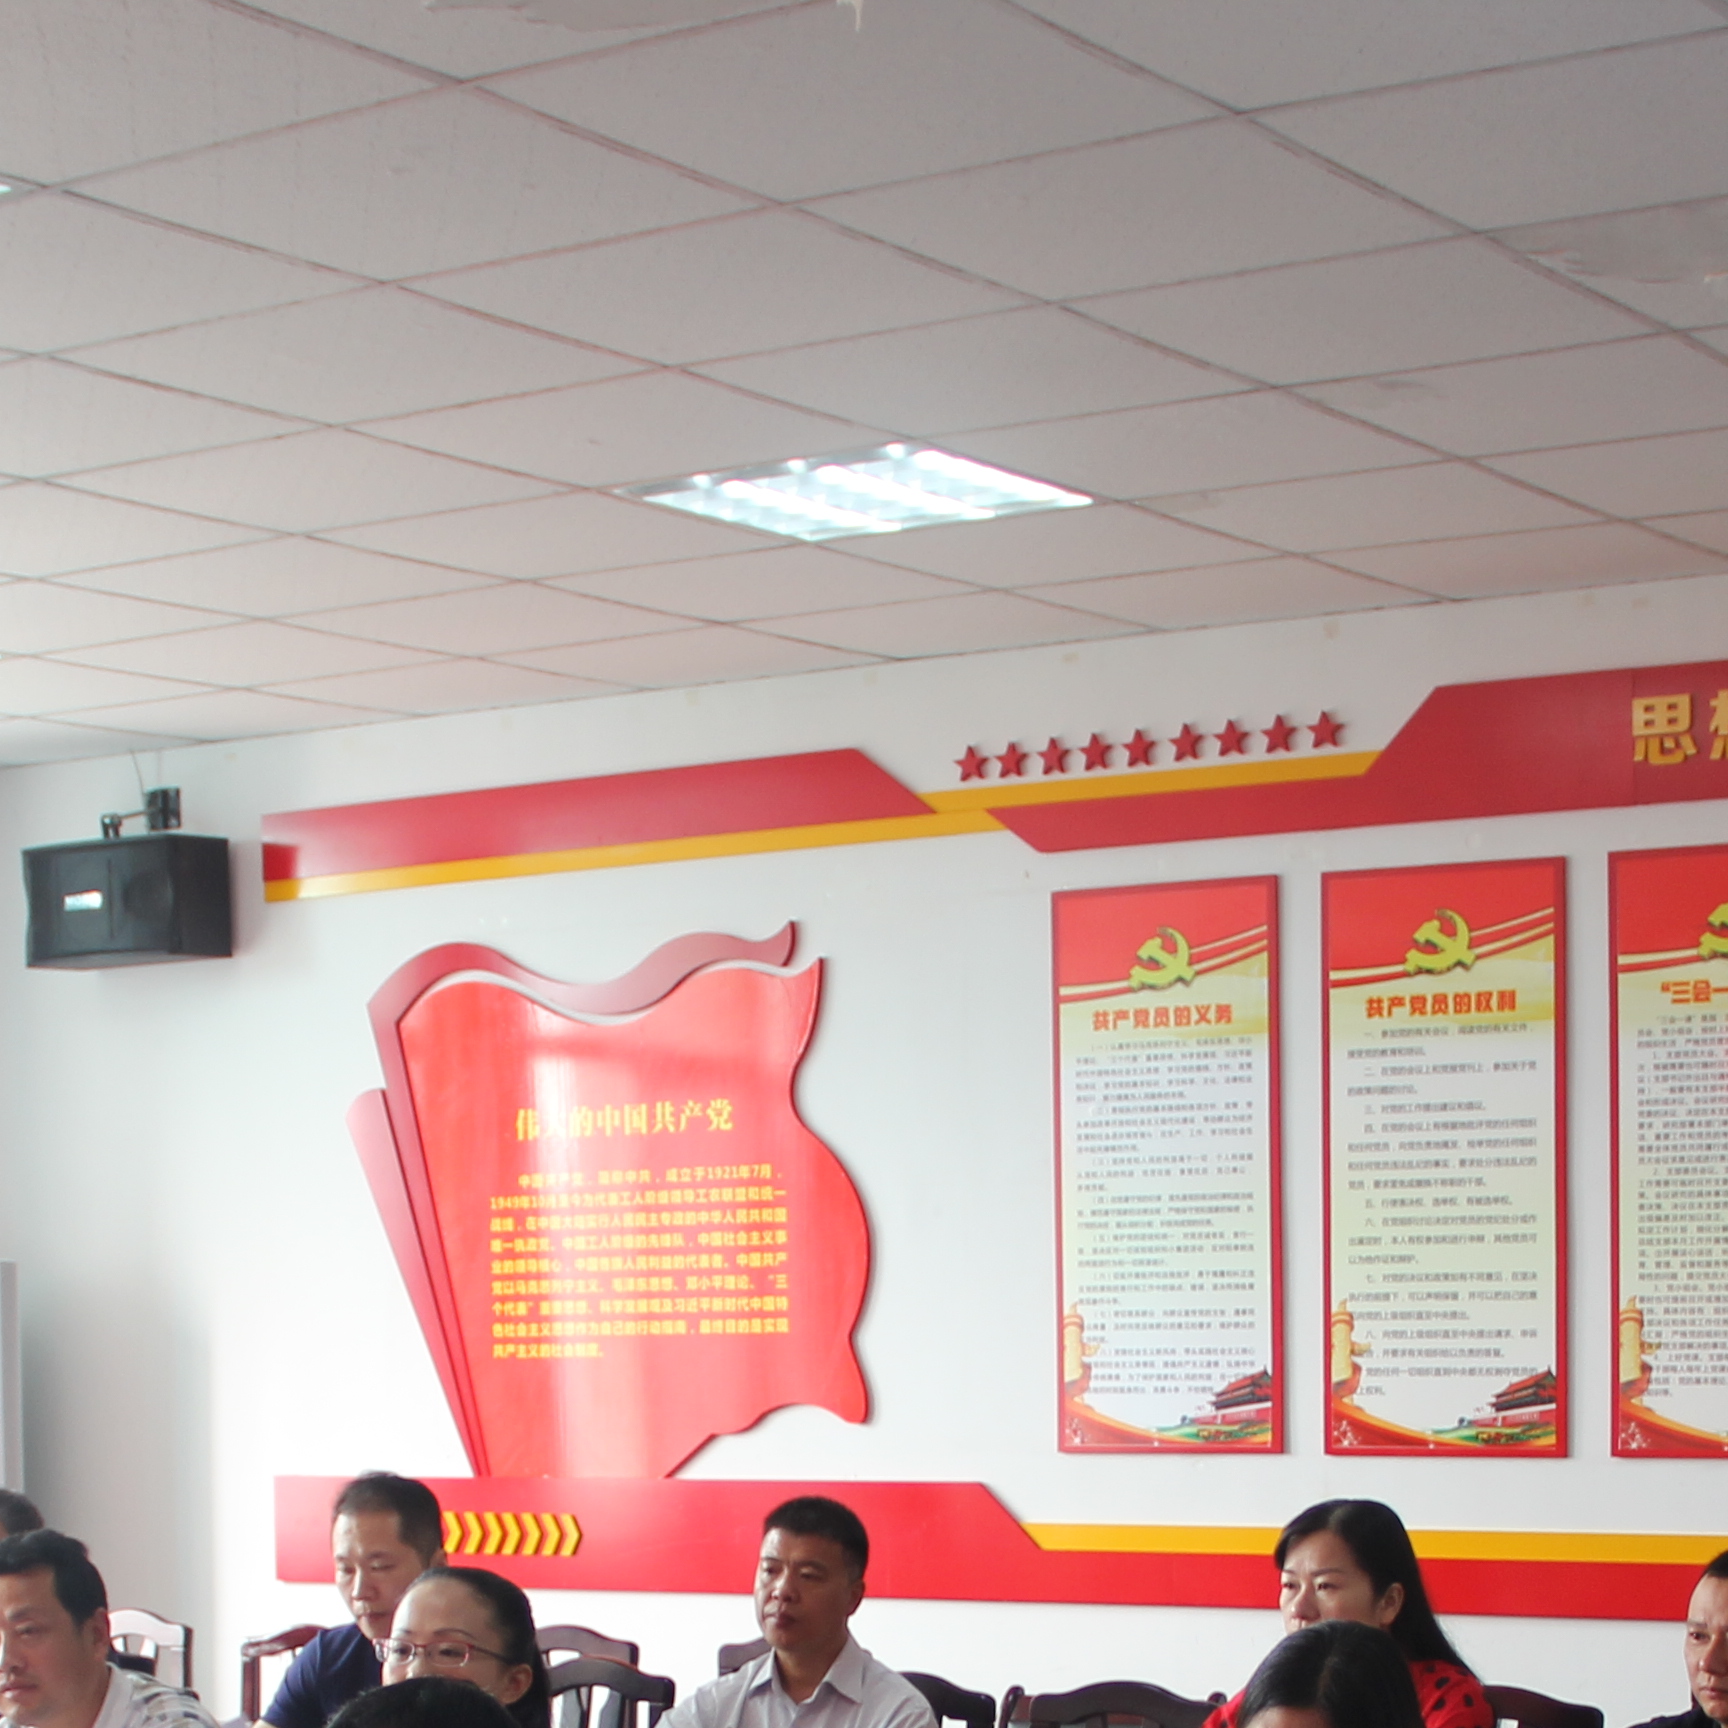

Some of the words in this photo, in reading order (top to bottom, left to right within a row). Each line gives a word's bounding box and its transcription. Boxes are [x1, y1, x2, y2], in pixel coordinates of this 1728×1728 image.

[1092, 1003, 1233, 1031] 共产党员的义务
[1365, 989, 1518, 1018] 共产党员的权利
